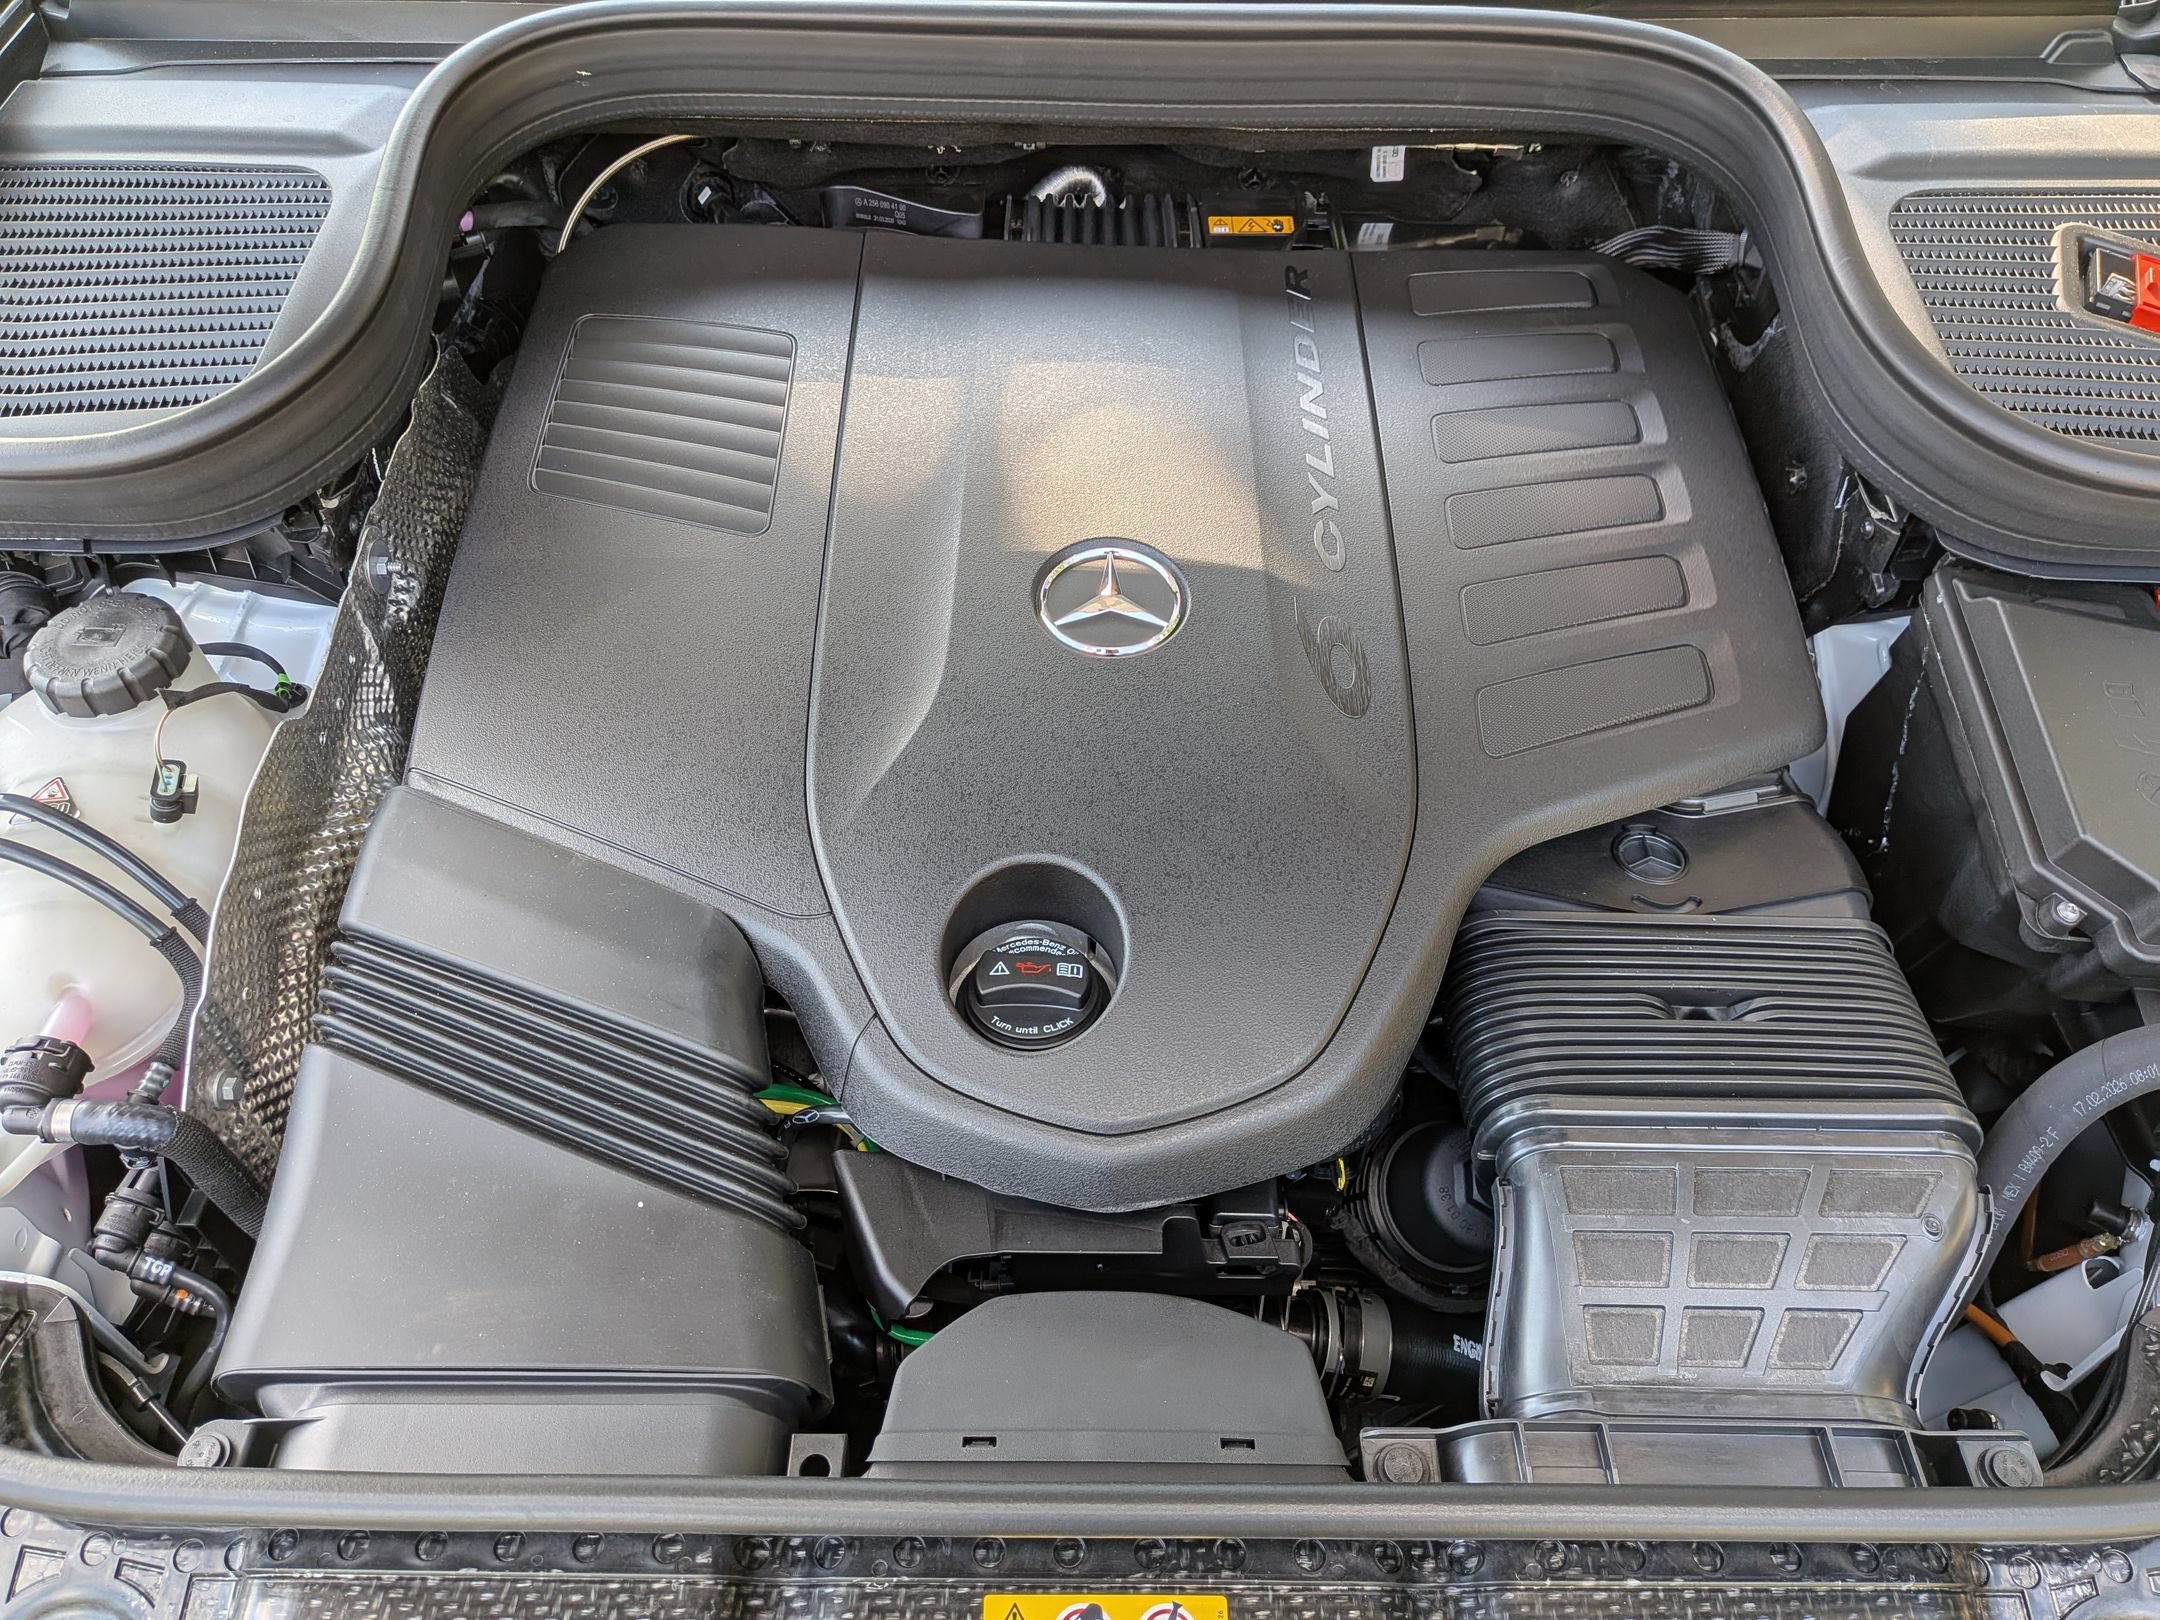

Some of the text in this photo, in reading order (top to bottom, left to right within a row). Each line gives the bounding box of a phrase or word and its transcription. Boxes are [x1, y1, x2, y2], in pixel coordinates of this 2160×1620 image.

[1284, 265, 1347, 573] CYLINDER
[118, 642, 149, 666] HEISS
[991, 1015, 1075, 1034] Turn until CLICK
